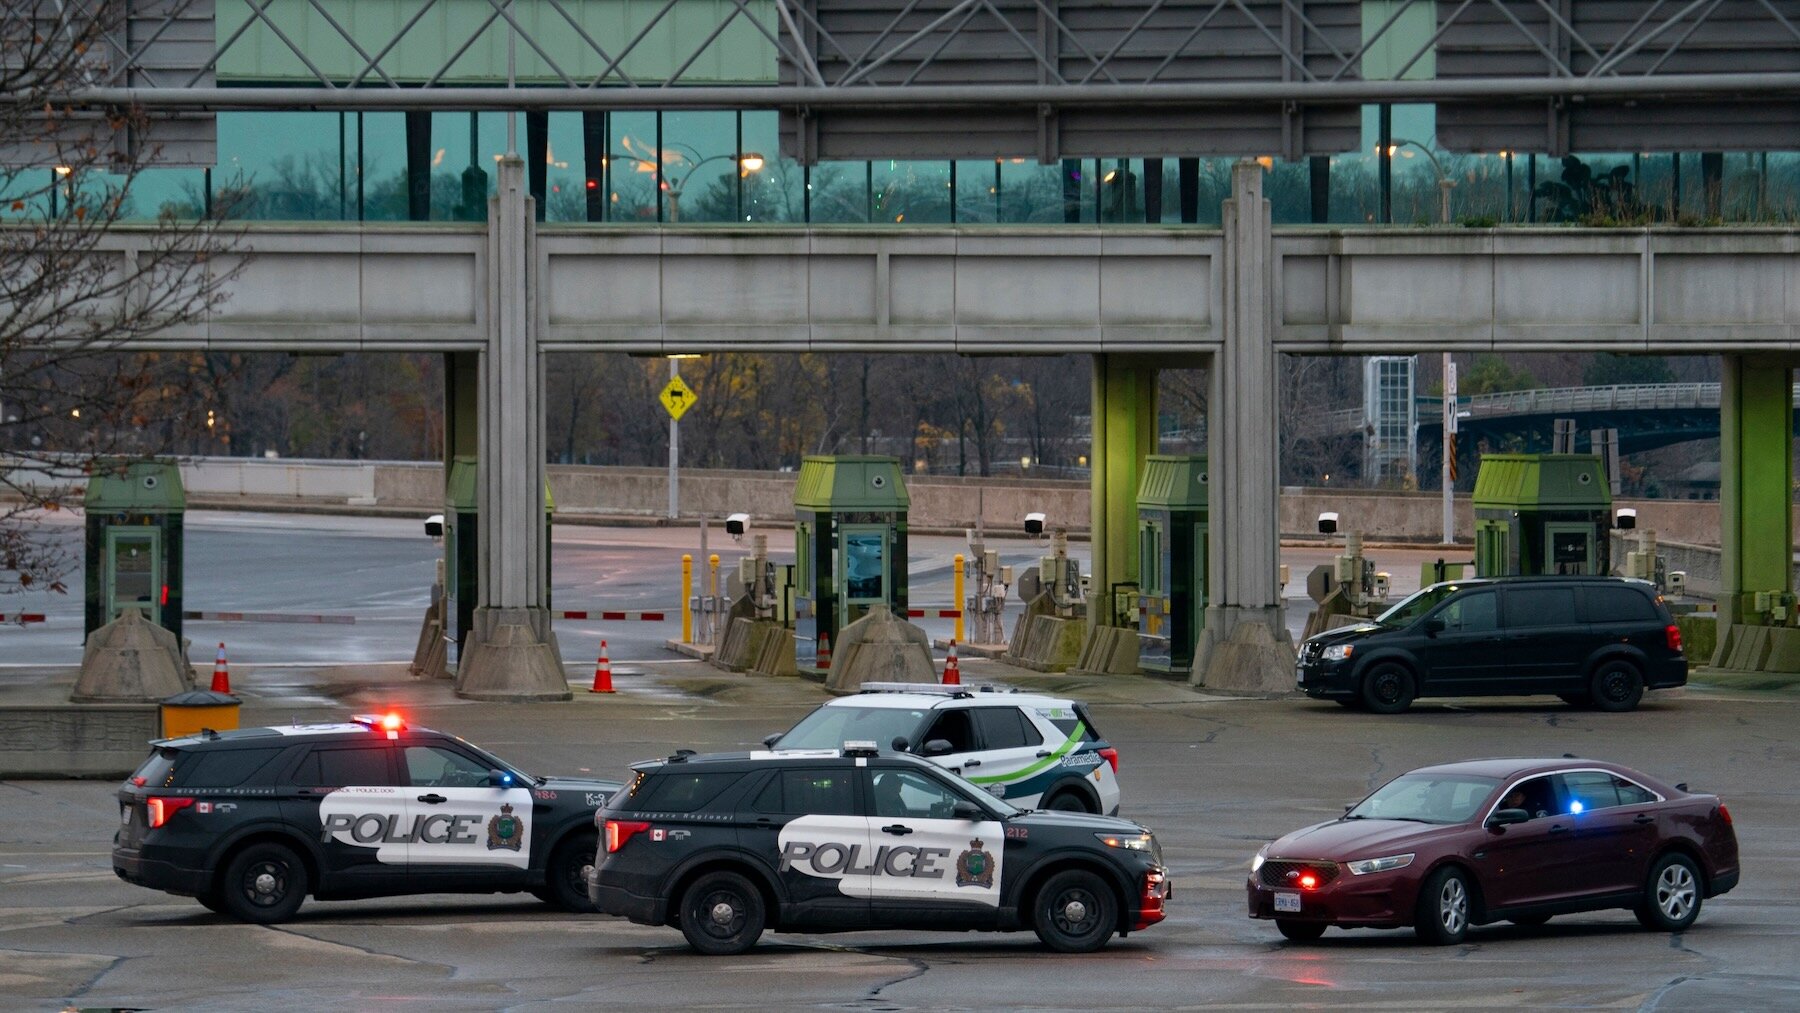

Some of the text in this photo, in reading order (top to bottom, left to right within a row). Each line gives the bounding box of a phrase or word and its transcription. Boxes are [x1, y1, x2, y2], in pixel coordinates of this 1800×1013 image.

[1060, 751, 1101, 767] Paramedic
[534, 790, 557, 800] 486
[585, 792, 605, 800] K-9
[683, 812, 733, 821] Regional
[321, 813, 483, 844] POLICE
[1007, 827, 1028, 838] 212
[780, 841, 951, 879] POLICE
